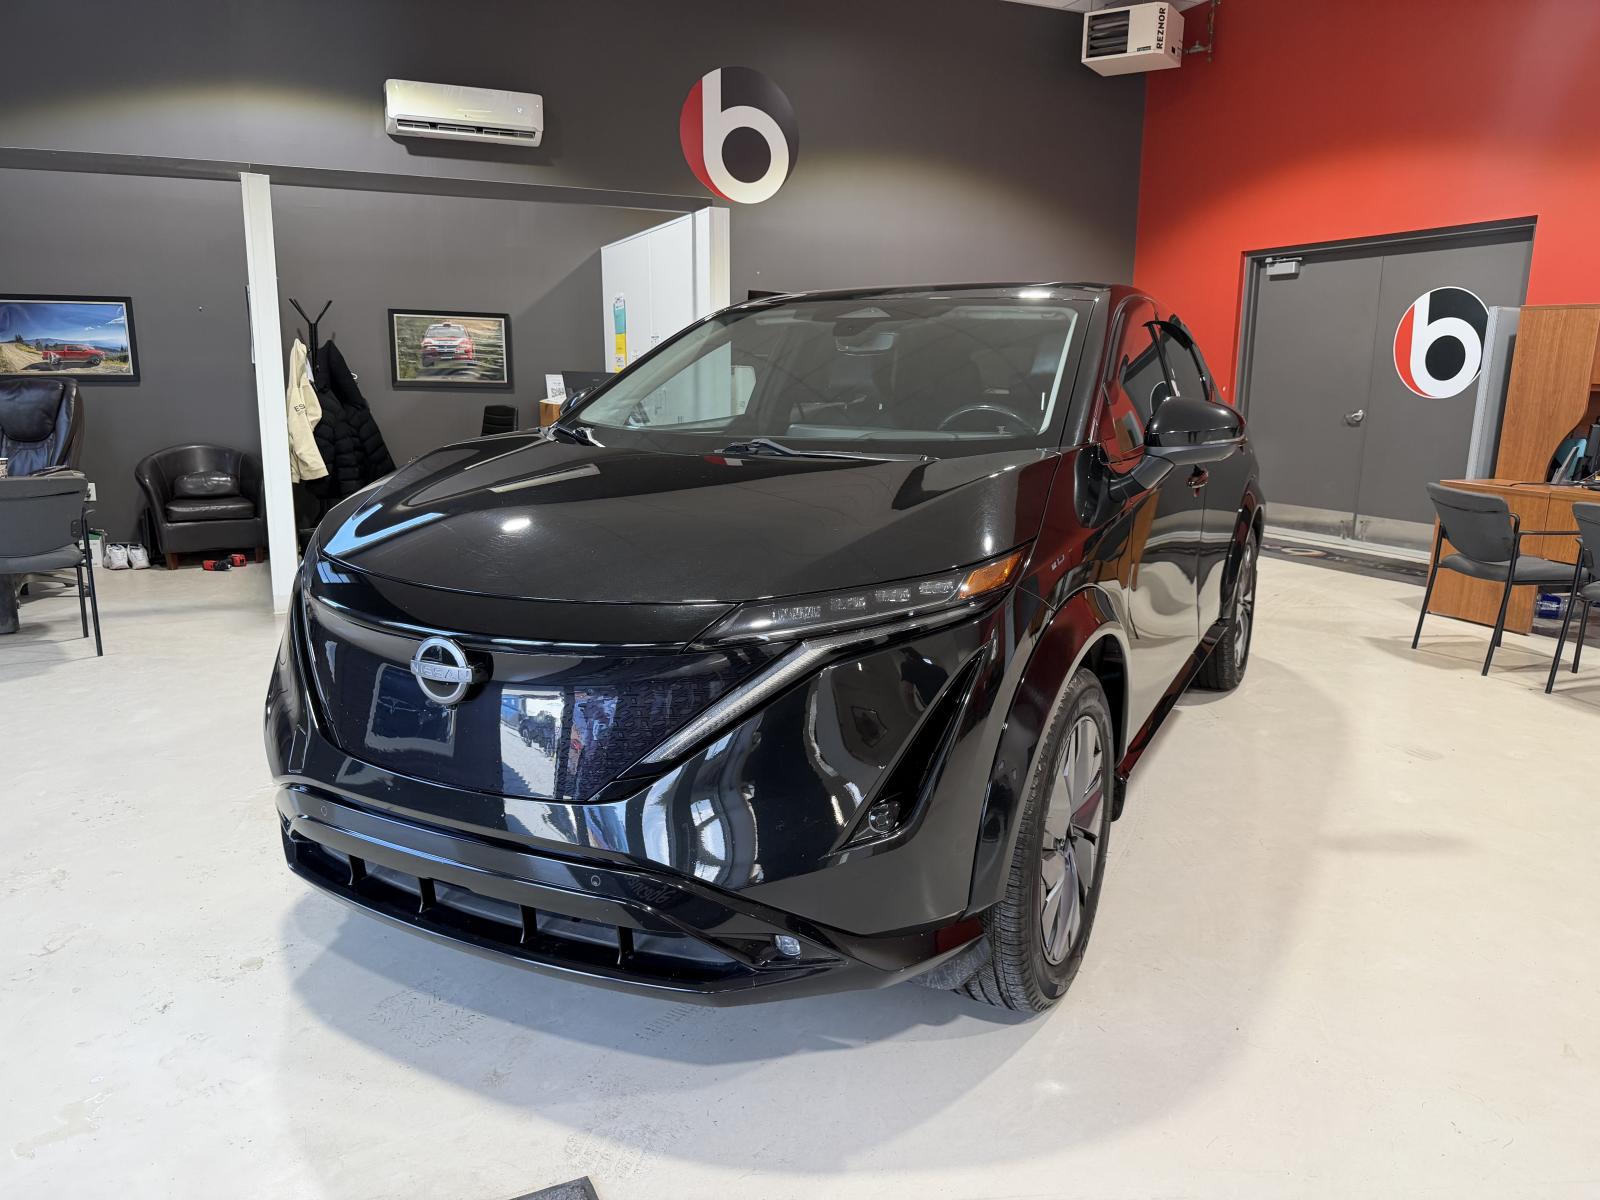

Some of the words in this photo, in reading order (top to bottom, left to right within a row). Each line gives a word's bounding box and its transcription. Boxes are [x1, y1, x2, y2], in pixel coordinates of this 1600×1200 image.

[1156, 7, 1167, 49] REZNOR
[702, 67, 789, 204] b
[411, 660, 471, 682] NISSAN
